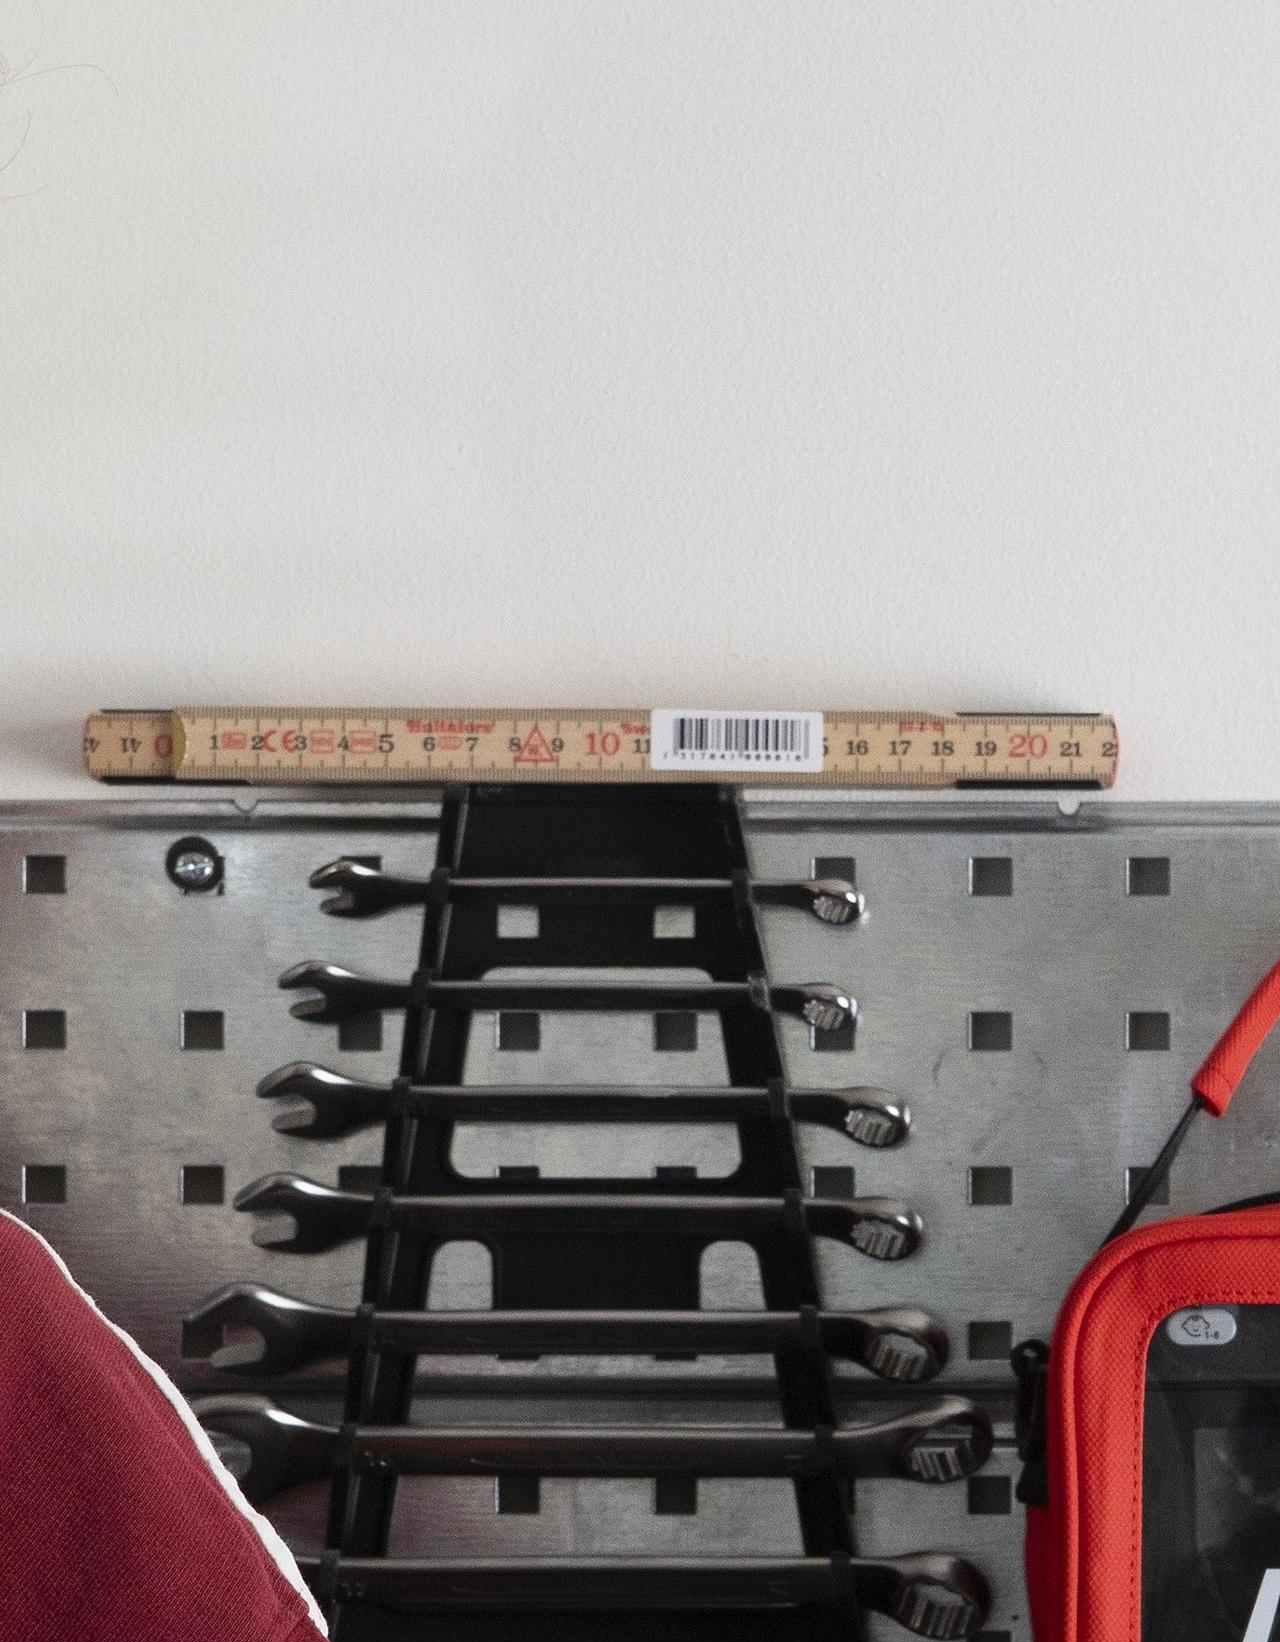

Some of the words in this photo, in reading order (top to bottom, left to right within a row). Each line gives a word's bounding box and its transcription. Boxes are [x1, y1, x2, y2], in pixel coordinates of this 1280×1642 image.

[210, 735, 219, 750] 1
[251, 736, 264, 751] 2
[295, 735, 307, 751] 3
[337, 736, 350, 751] 4
[377, 733, 395, 753] 5
[423, 736, 436, 752] 6
[466, 736, 480, 752] 7
[508, 737, 521, 753] 8
[551, 737, 564, 753] 9
[584, 732, 620, 756] 10
[846, 739, 869, 755] 16
[889, 740, 912, 756] 17
[932, 740, 954, 756] 18
[975, 740, 998, 757] 19
[1007, 733, 1048, 758] 20
[1059, 741, 1082, 757] 21
[1101, 742, 1119, 757] 2
